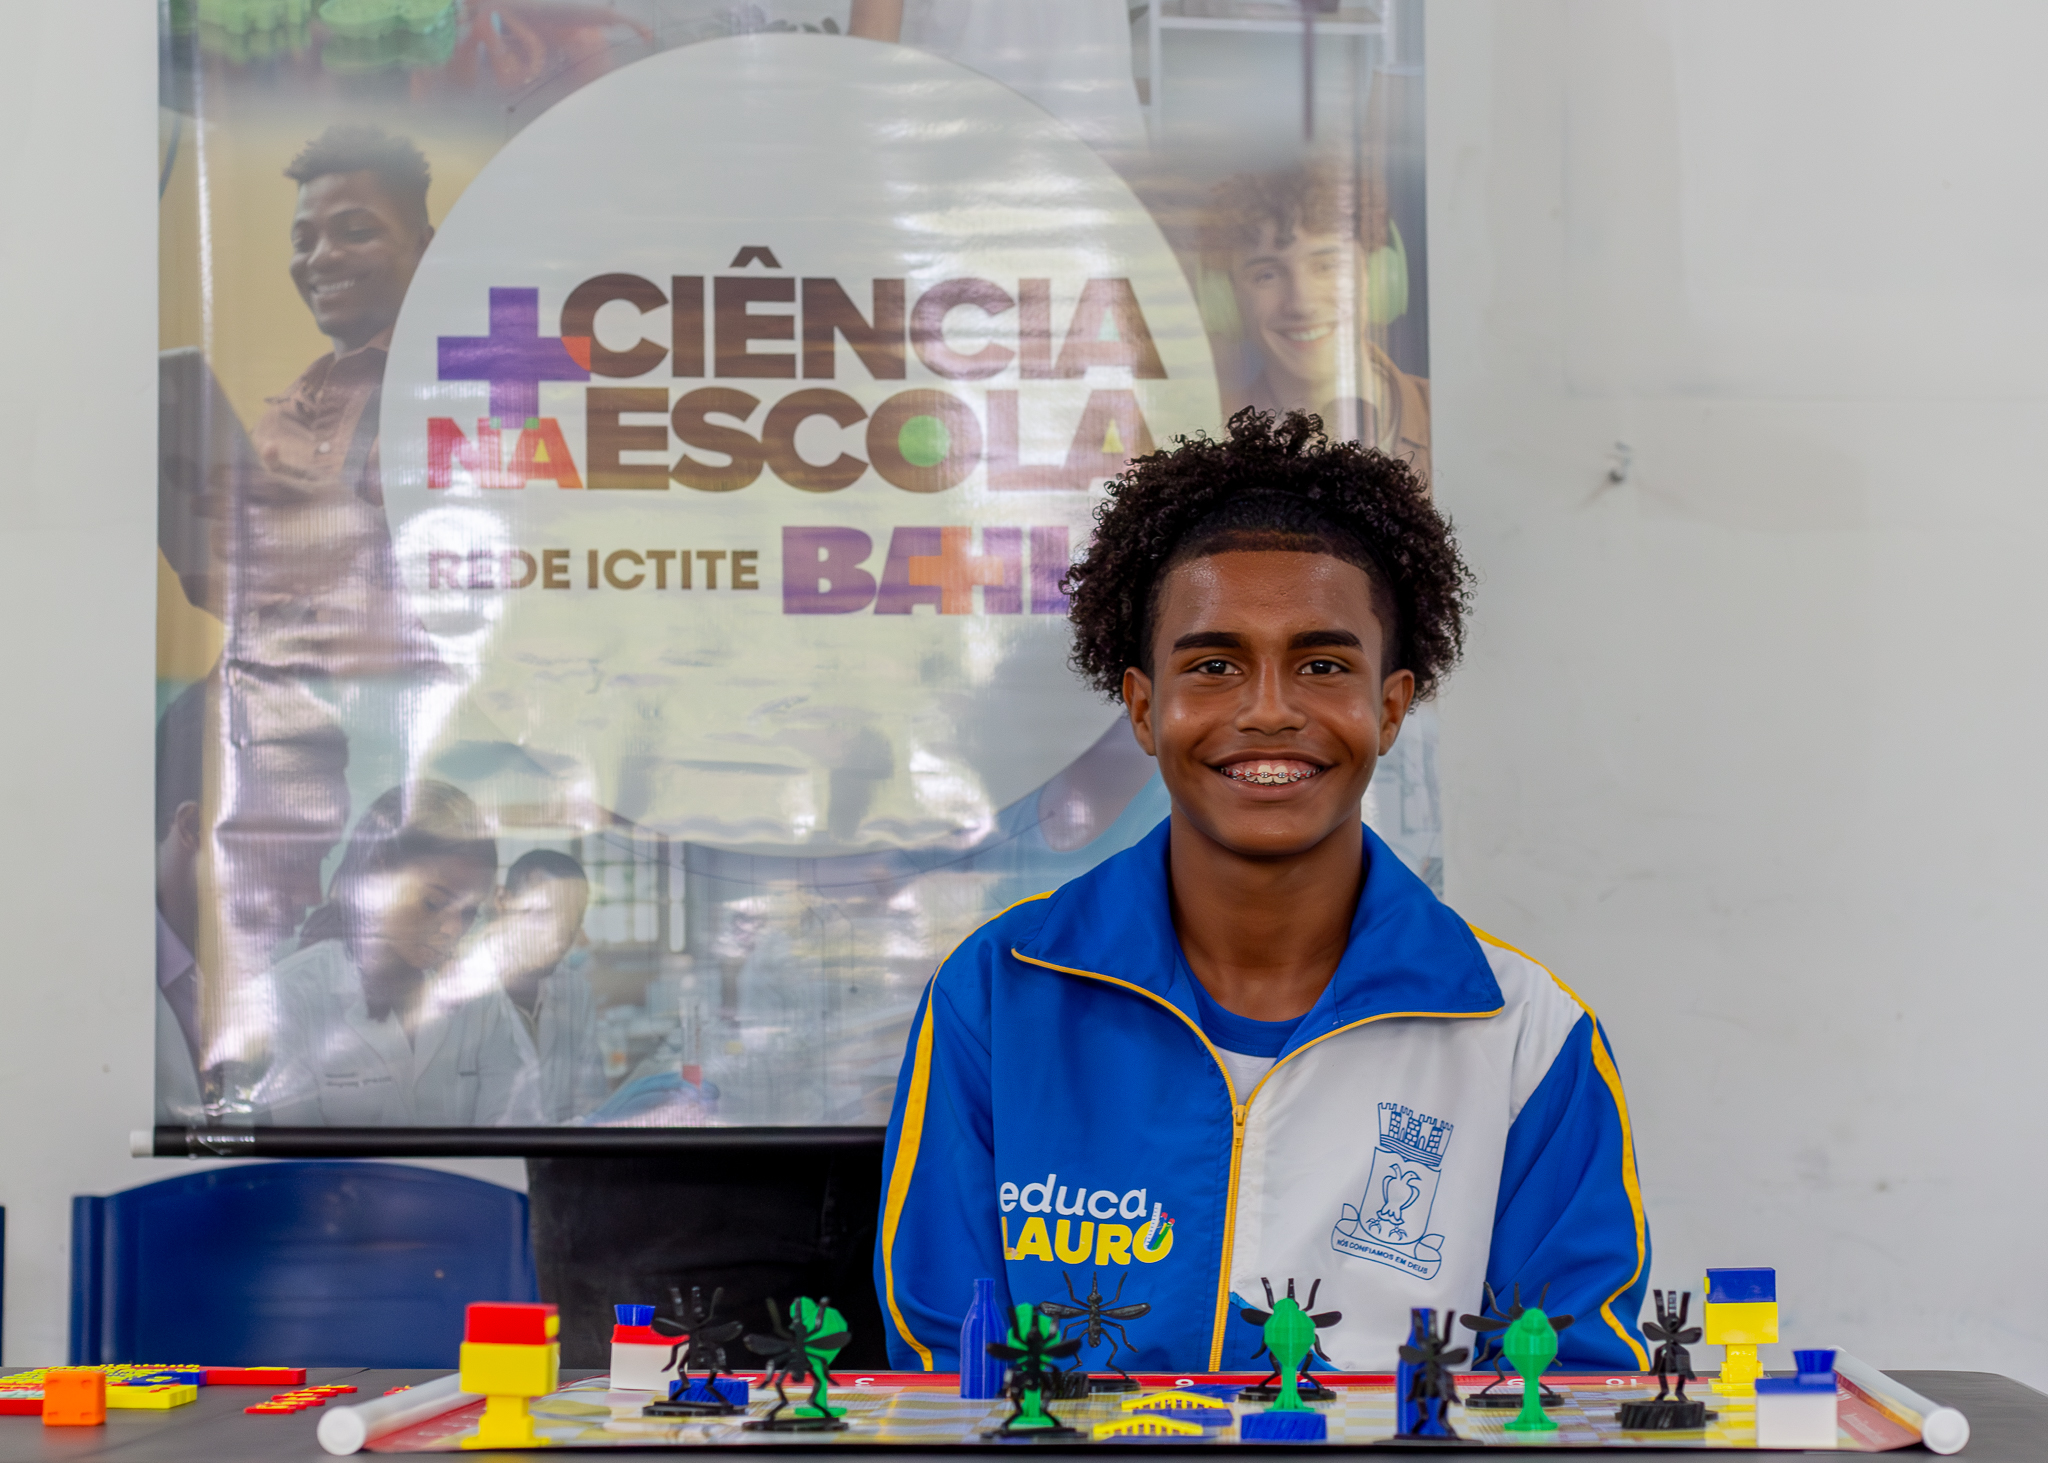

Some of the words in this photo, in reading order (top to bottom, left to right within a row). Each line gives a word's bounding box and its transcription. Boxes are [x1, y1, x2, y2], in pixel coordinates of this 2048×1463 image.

[586, 387, 1159, 493] ESCOLA
[428, 549, 571, 590] REDE
[588, 549, 760, 590] ICTITE
[782, 526, 1098, 615] BAHI
[1000, 1173, 1147, 1219] educa
[1001, 1216, 1173, 1266] LAURO
[1337, 1238, 1348, 1247] NÓS
[1349, 1242, 1394, 1260] CONFIAMOS
[1395, 1256, 1406, 1265] EM
[1407, 1261, 1428, 1274] DEUS
